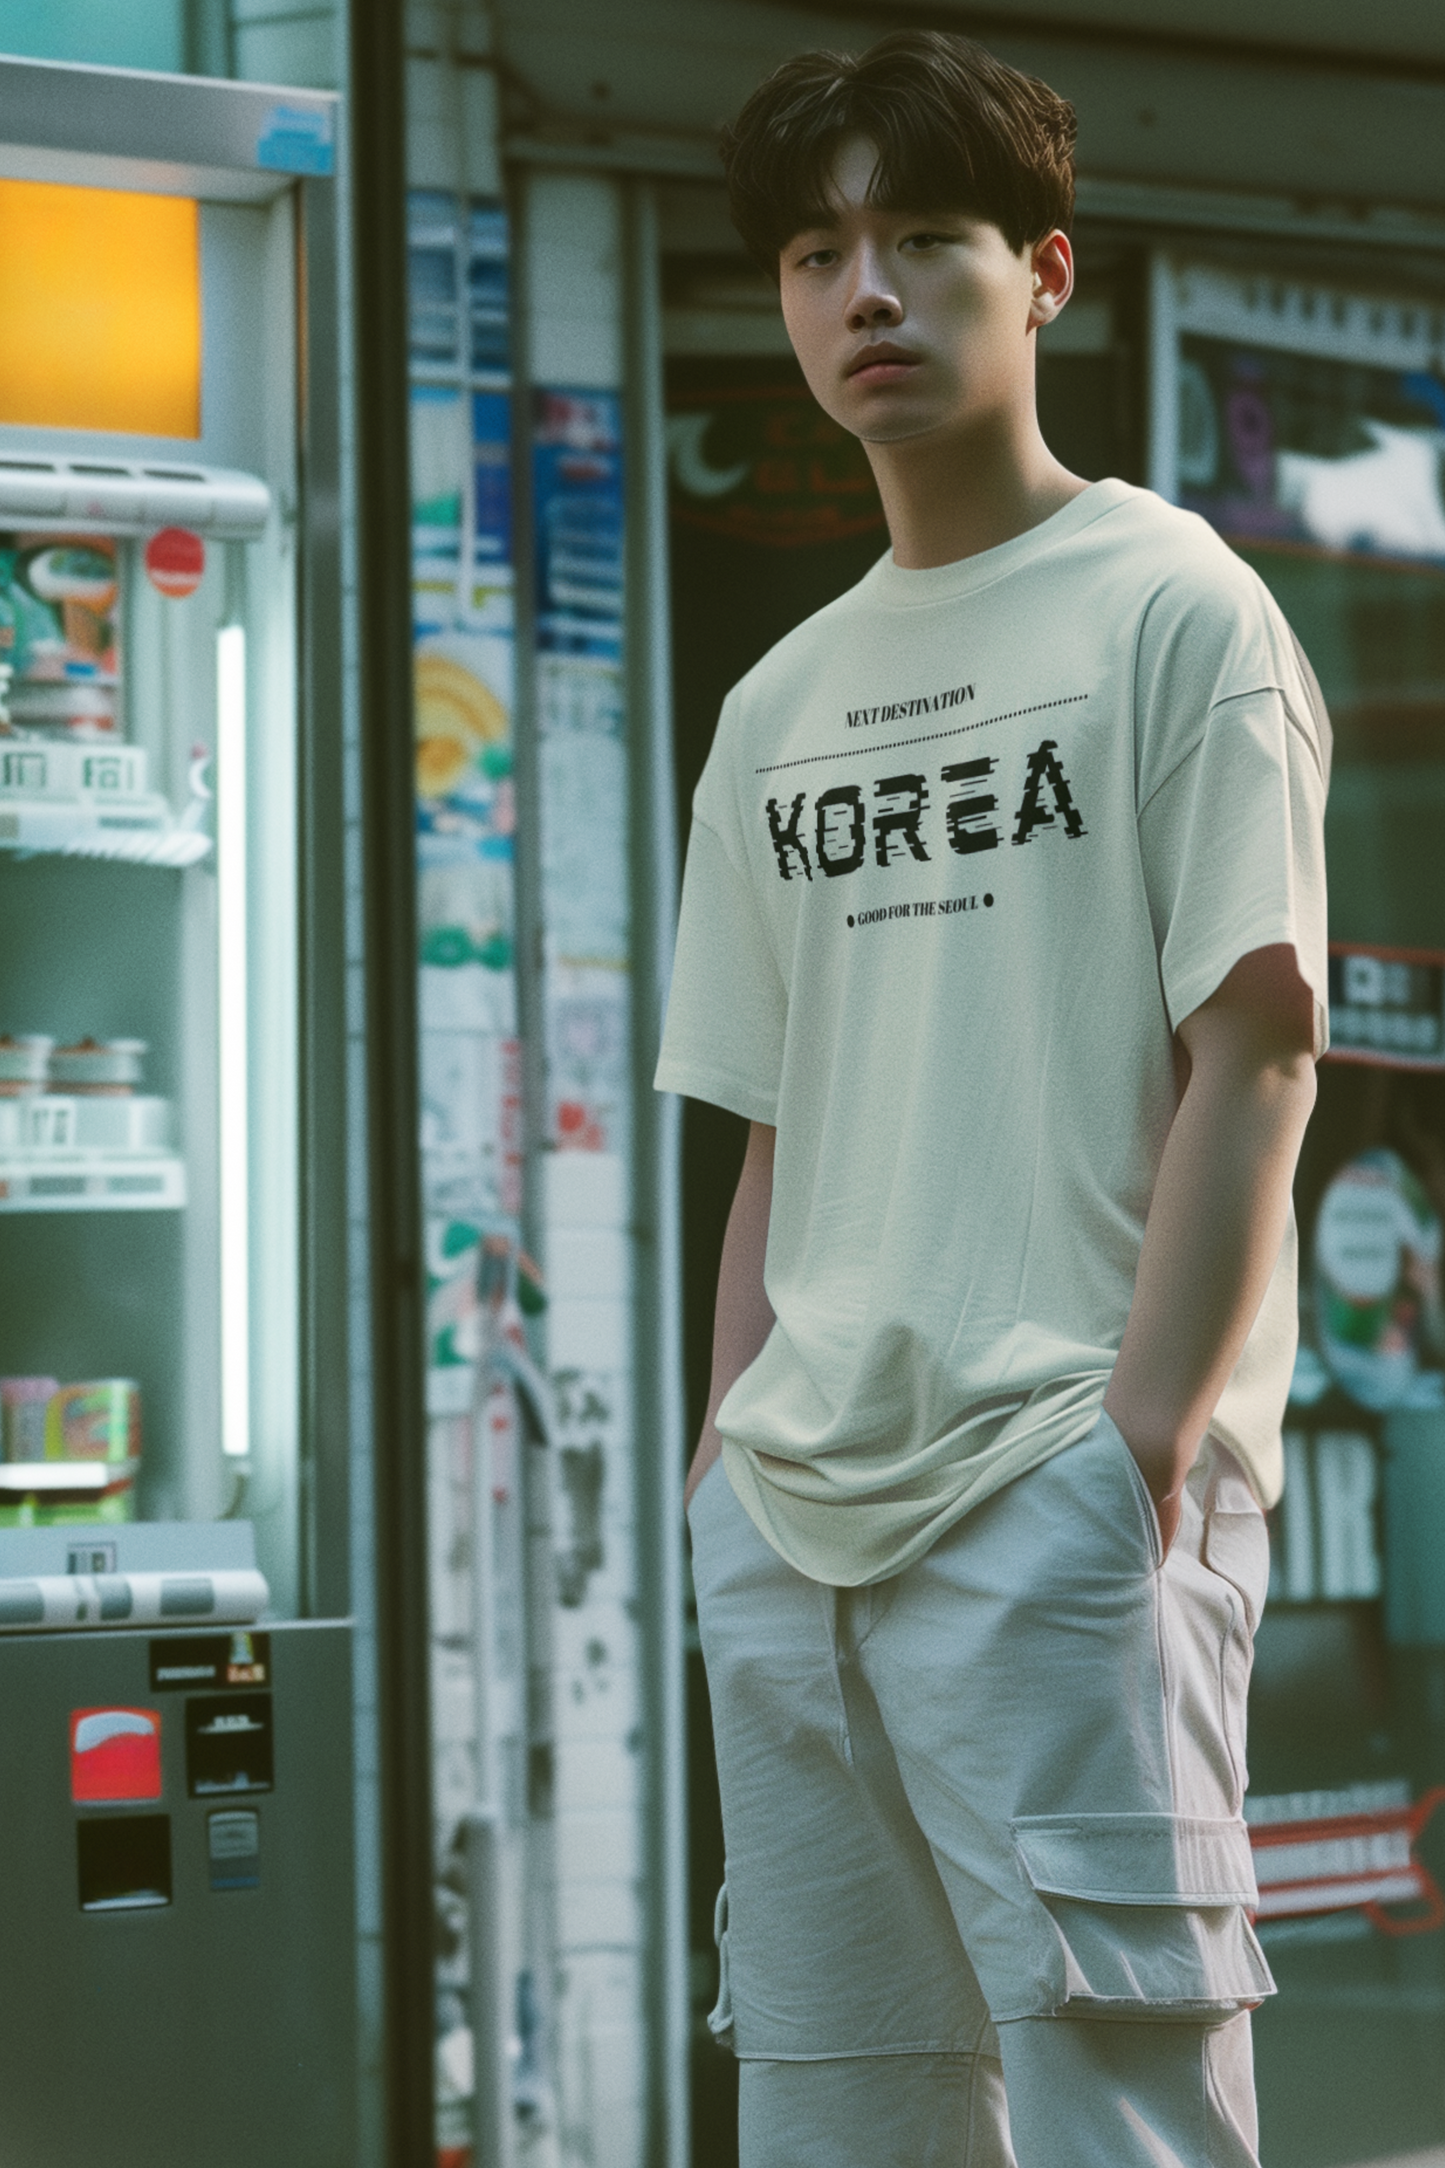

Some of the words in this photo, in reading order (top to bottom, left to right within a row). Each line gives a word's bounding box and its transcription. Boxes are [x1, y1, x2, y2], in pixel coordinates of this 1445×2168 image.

[845, 707, 880, 728] NEXT
[881, 683, 976, 722] DESTINATION
[765, 740, 1089, 881] KOREA
[858, 908, 887, 925] GOOD
[888, 904, 910, 919] FOR
[912, 902, 936, 916] THE
[938, 895, 978, 915] SEOUL
